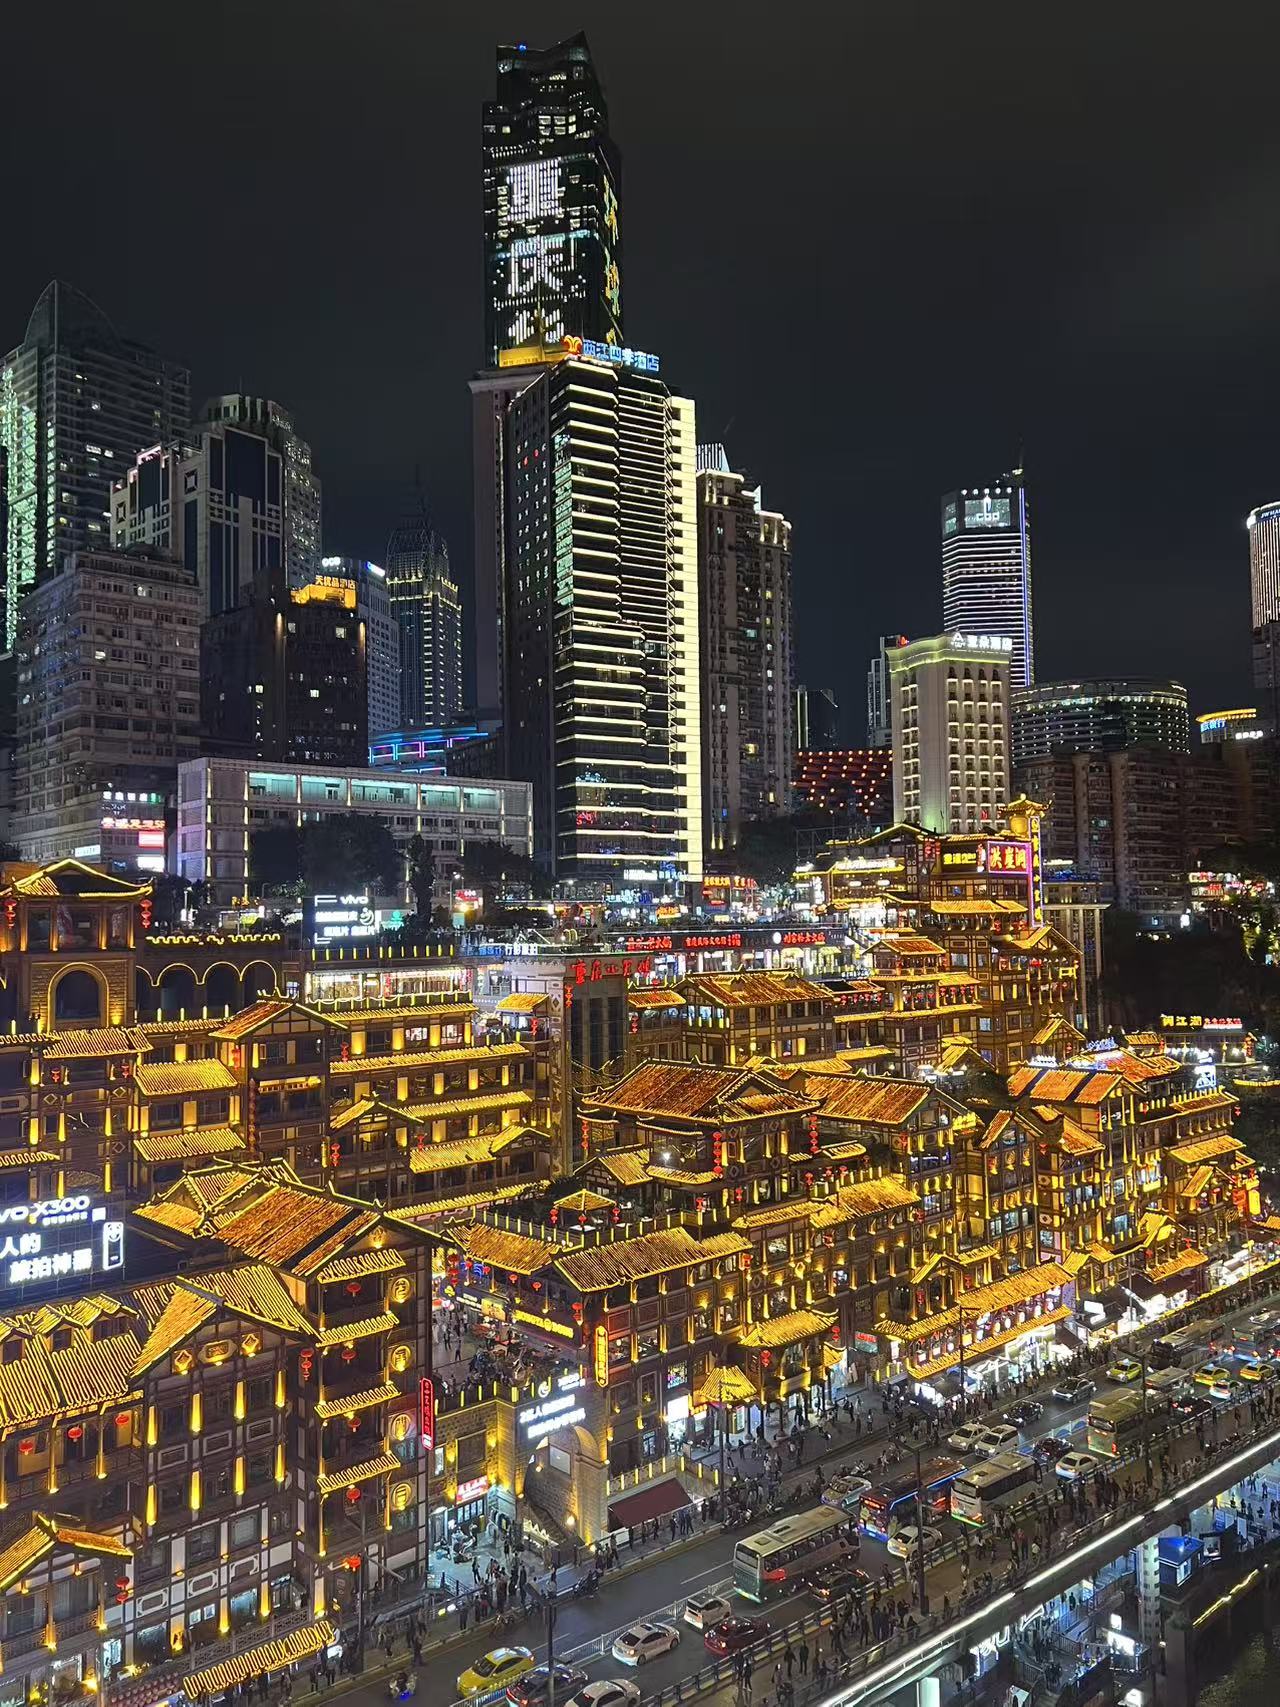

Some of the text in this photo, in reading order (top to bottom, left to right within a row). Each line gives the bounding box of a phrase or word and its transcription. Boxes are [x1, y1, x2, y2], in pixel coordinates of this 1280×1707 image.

[990, 846, 1027, 869] 洪崖洞
[340, 894, 369, 905] vivo
